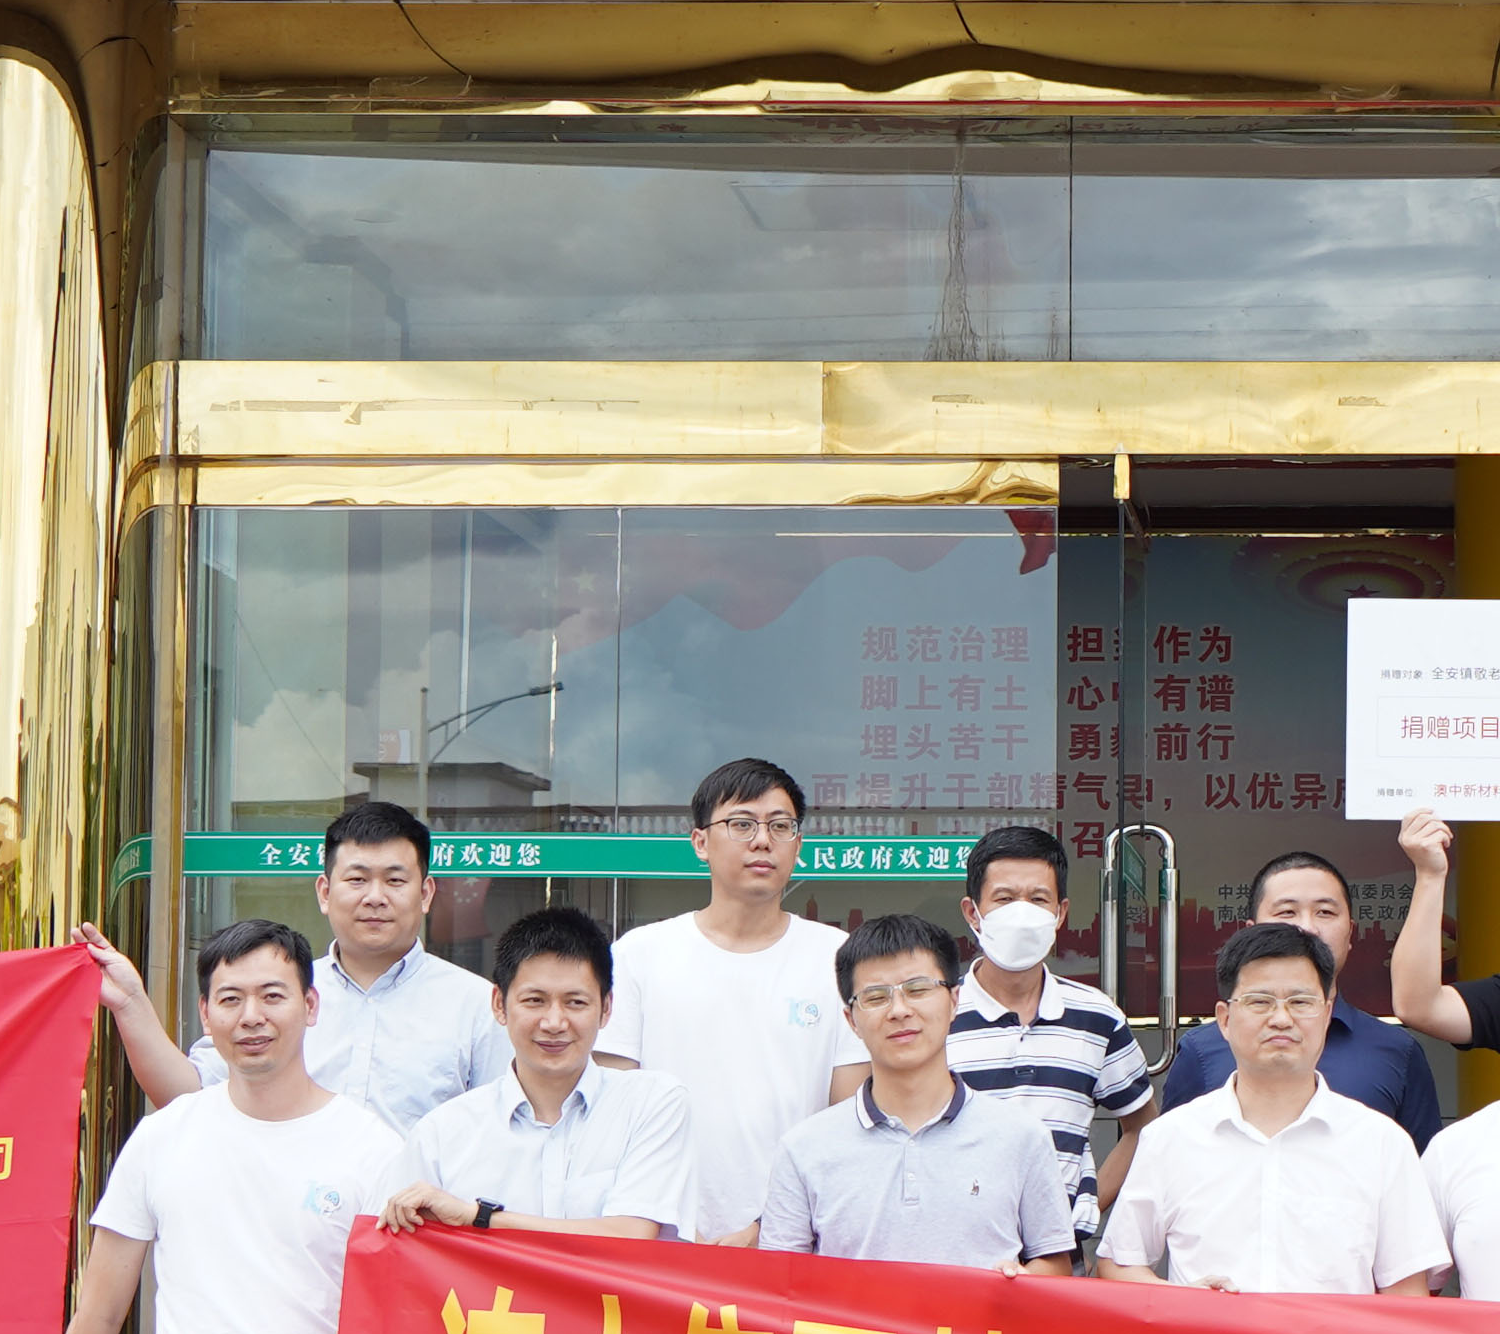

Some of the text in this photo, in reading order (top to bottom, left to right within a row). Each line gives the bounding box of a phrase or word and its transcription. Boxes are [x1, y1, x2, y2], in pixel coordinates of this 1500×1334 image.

[860, 624, 1233, 664] 规范治理 担作为
[859, 673, 1236, 713] 脚上有土 心有谱
[859, 722, 1030, 762] 埋头苦干
[1400, 714, 1500, 740] 捐赠项目
